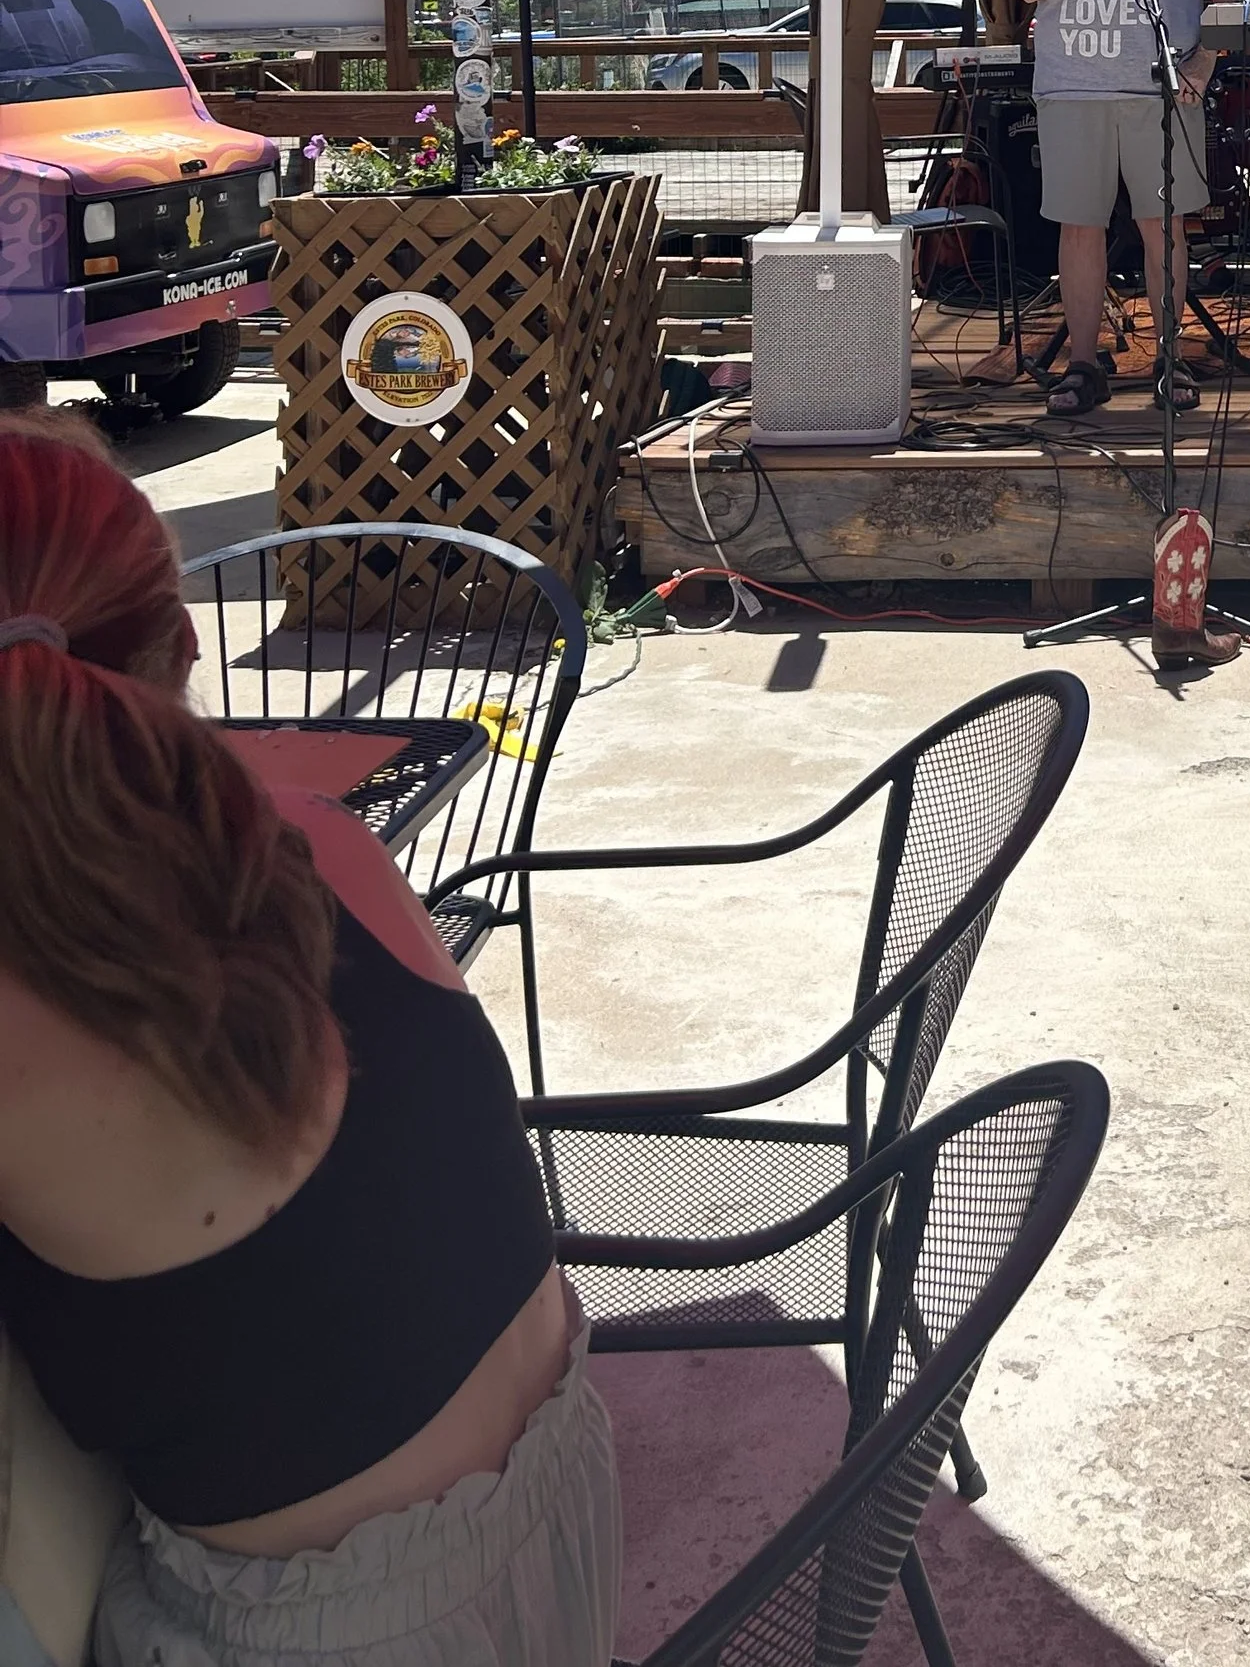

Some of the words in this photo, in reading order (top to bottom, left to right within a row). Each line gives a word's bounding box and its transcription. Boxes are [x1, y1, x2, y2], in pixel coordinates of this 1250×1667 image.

[1060, 28, 1121, 58] YOU
[163, 269, 248, 306] KONA-ICE.COM
[360, 374, 387, 388] ESTES
[389, 374, 413, 388] PARK
